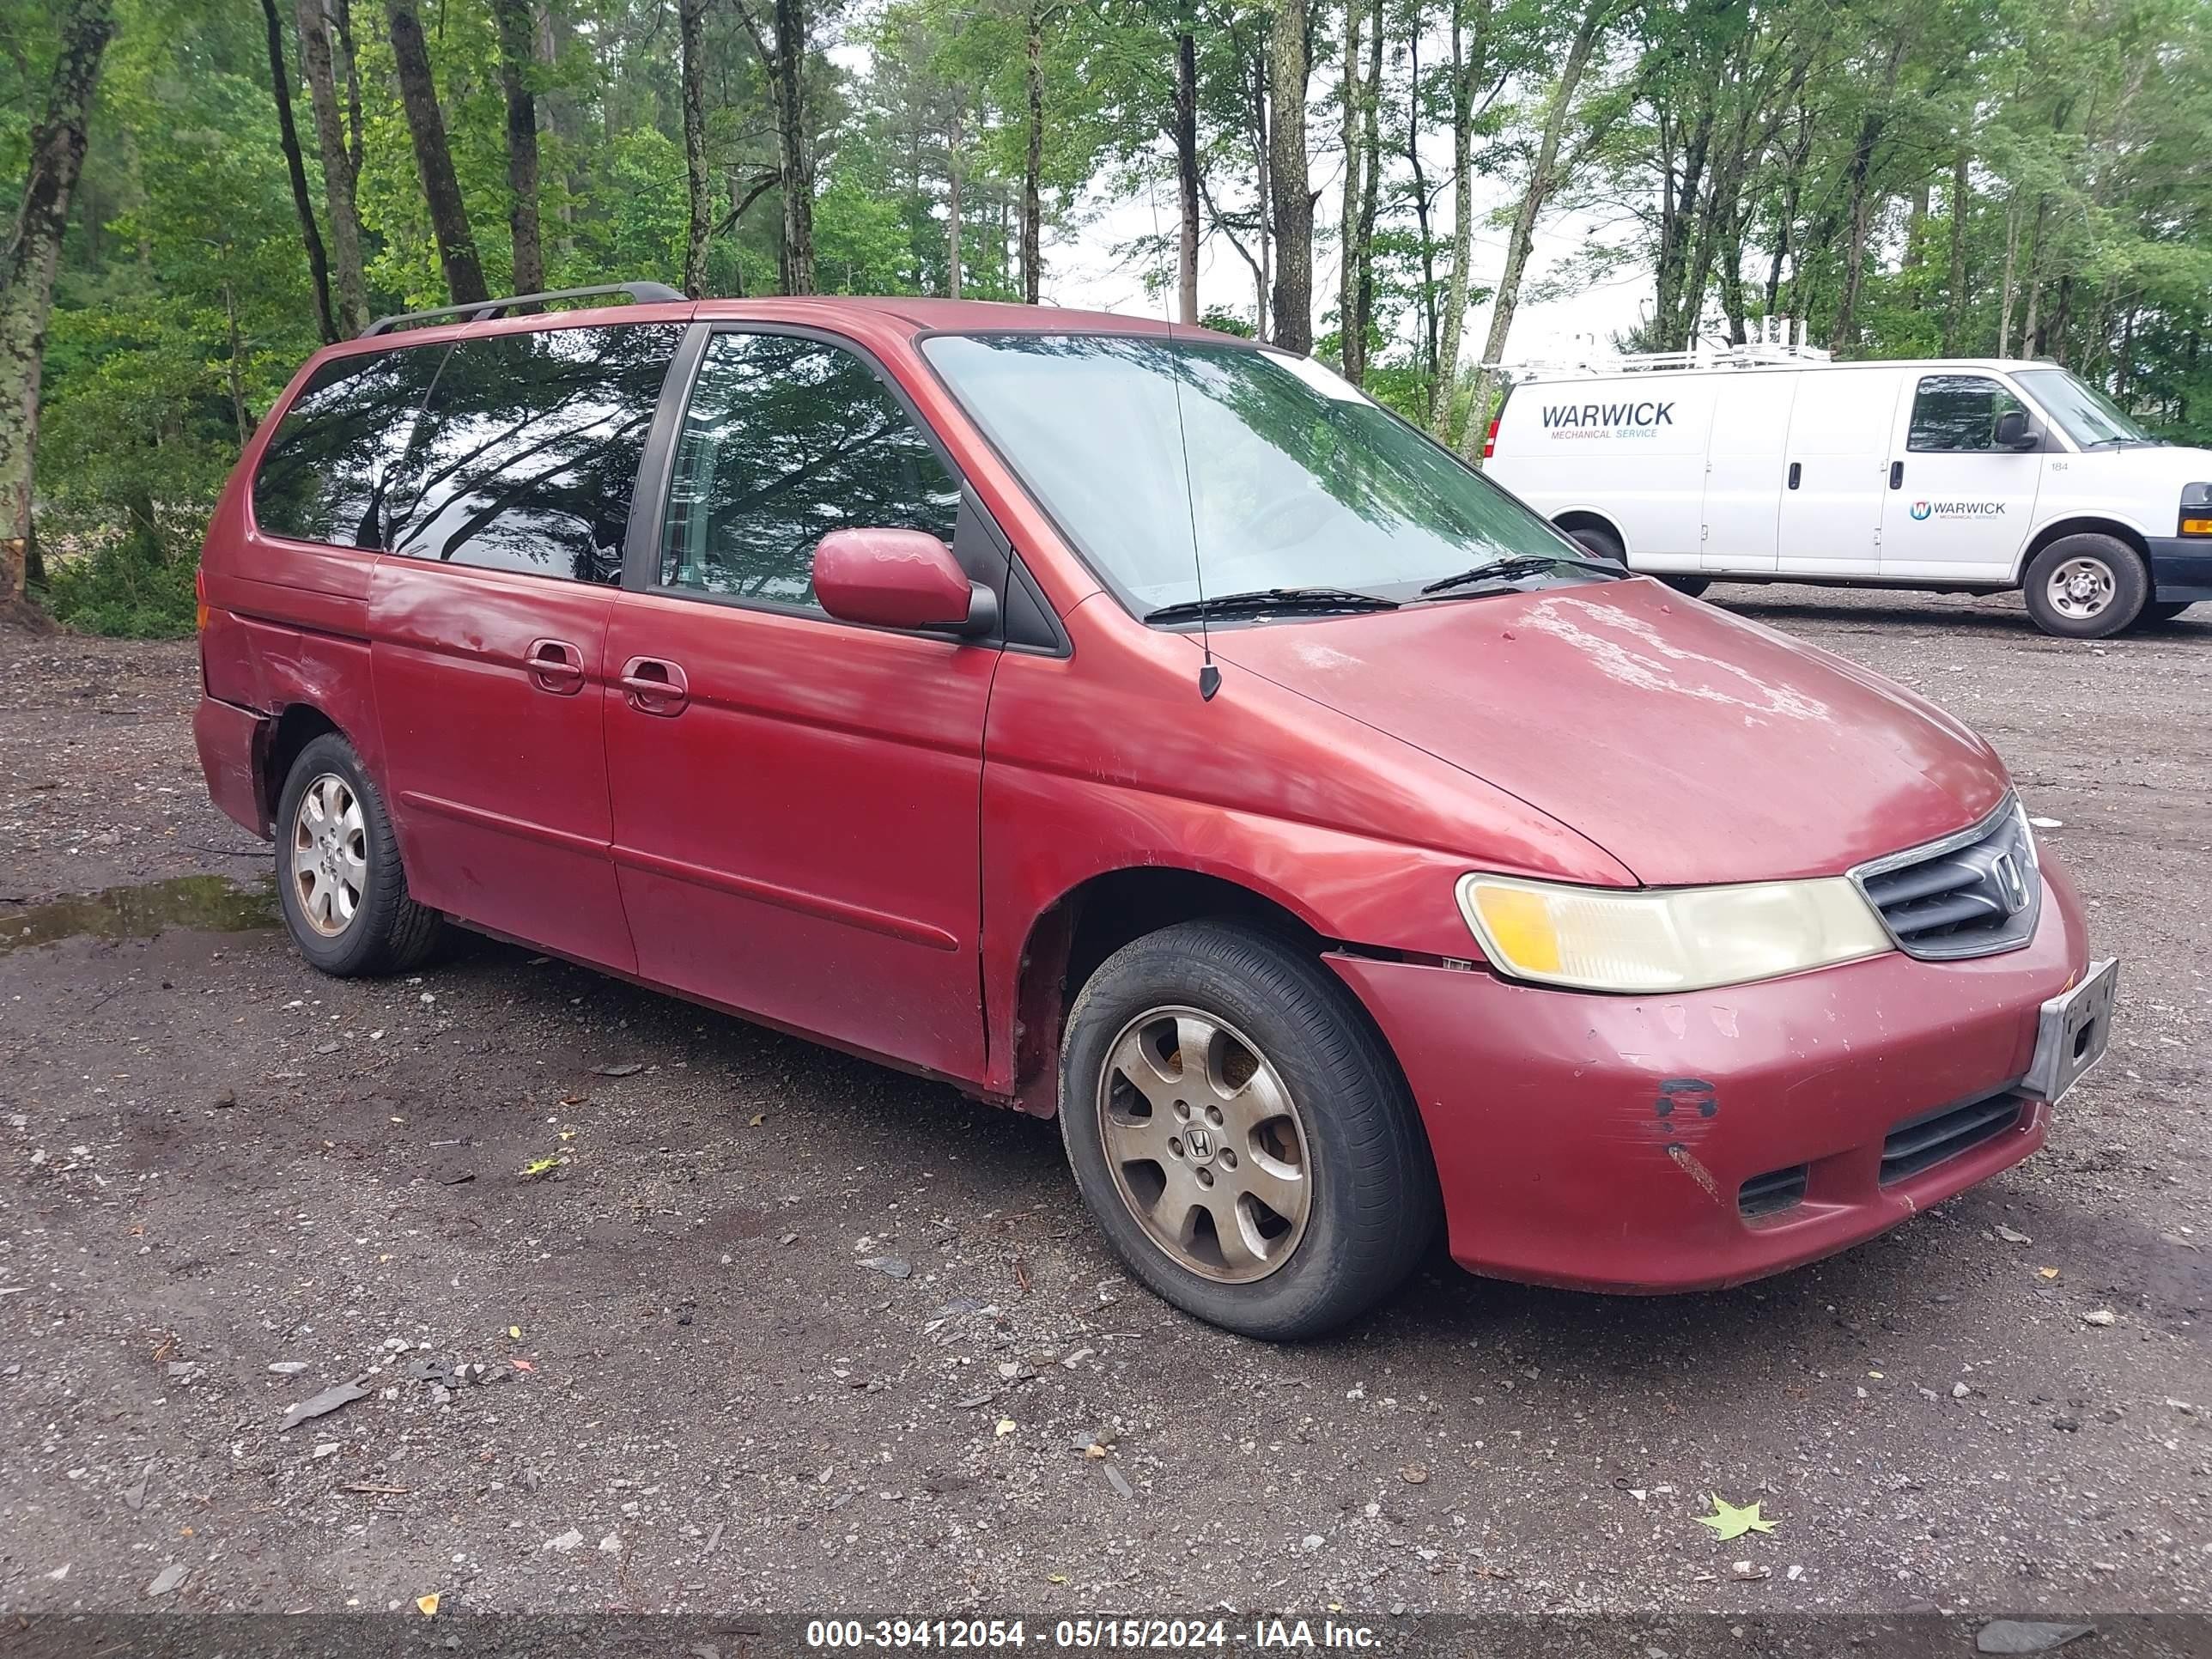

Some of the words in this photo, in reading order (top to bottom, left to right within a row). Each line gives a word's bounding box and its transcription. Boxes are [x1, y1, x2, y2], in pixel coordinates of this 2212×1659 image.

[1542, 402, 1676, 428] WARWICK
[1551, 430, 1611, 440] MECHANICAL
[1615, 428, 1658, 439] SERVICE
[2051, 462, 2069, 471] 184
[1934, 502, 2006, 514] WARWICK
